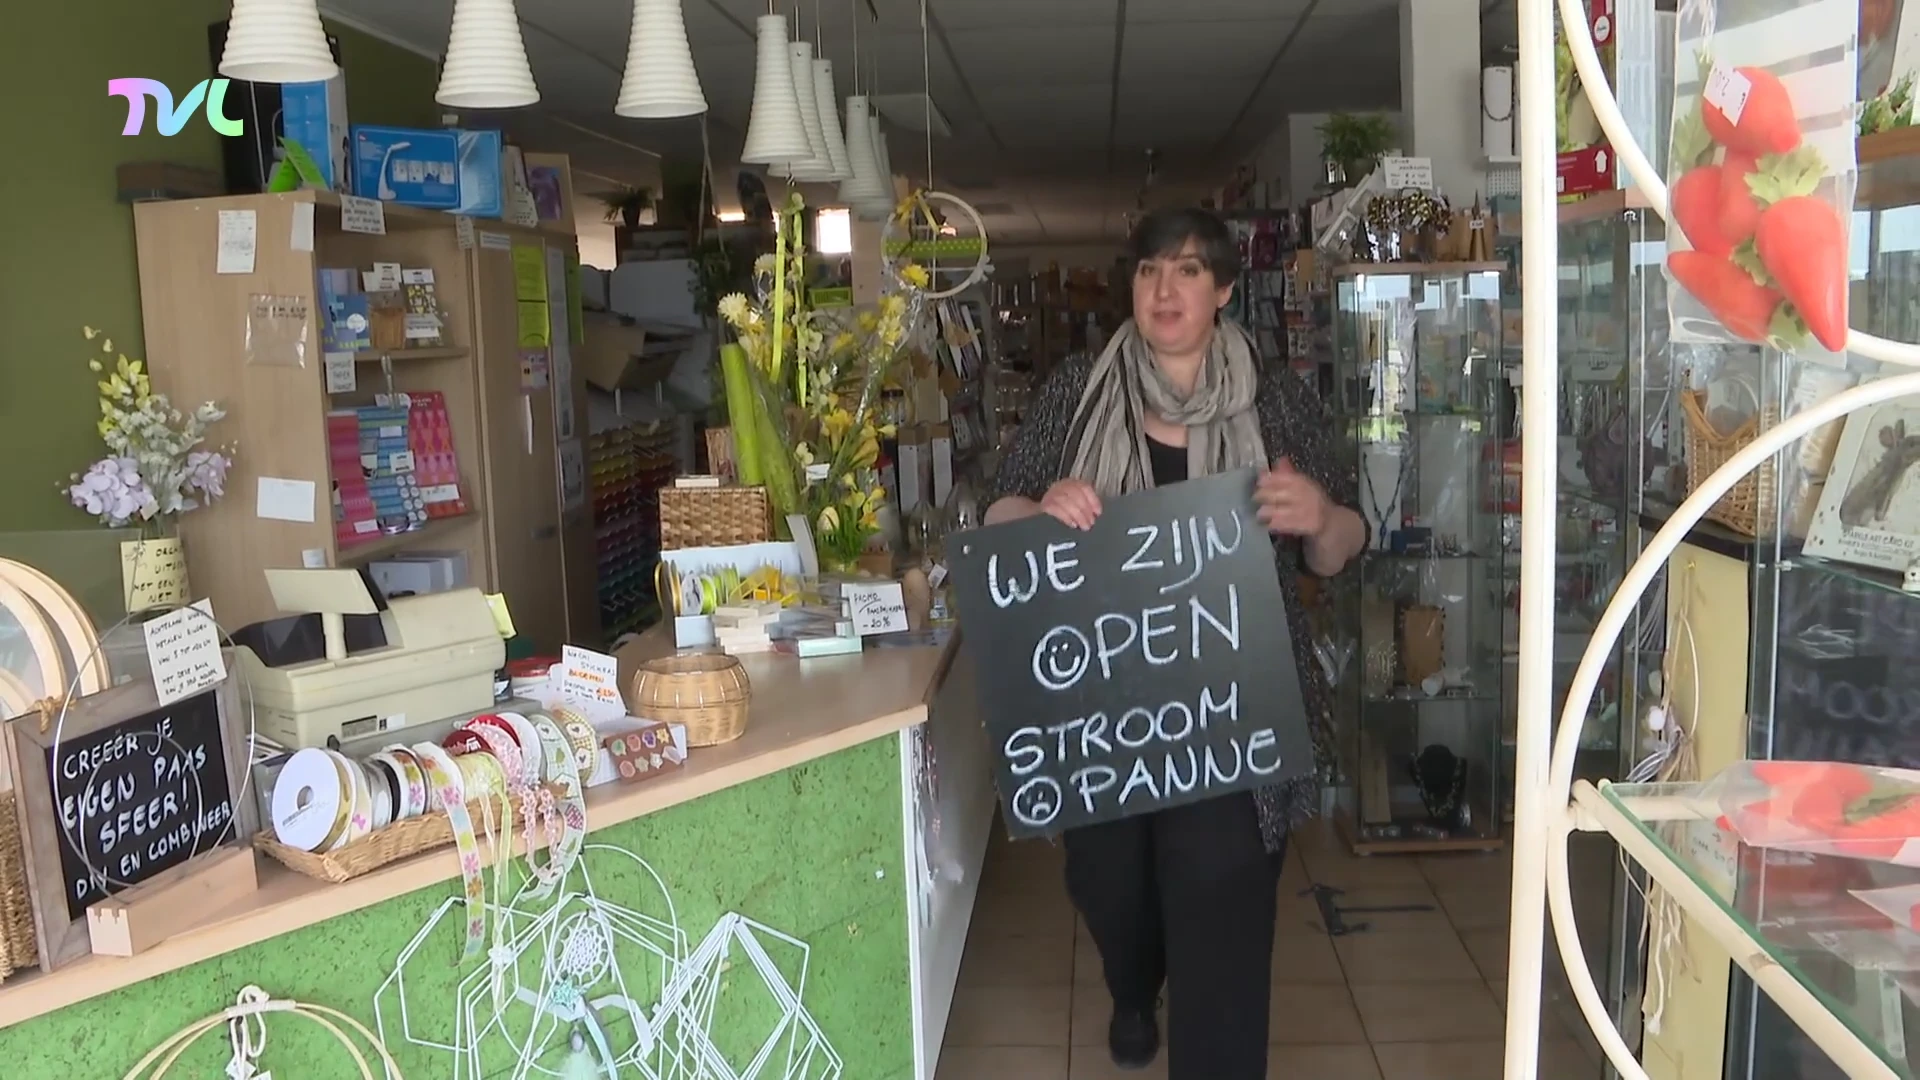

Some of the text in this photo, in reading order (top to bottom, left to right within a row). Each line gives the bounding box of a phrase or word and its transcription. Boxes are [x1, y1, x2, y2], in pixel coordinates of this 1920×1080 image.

[988, 508, 1243, 608] WE ZIJN
[1032, 583, 1240, 690] OPEN
[148, 717, 173, 756] JE
[1004, 681, 1238, 776] STROOM
[1069, 728, 1281, 813] PANNE
[63, 744, 206, 829] EIGEN PAAS
[100, 777, 189, 854] SFEER!
[121, 851, 140, 877] EN
[149, 801, 231, 861] COMBINEER
